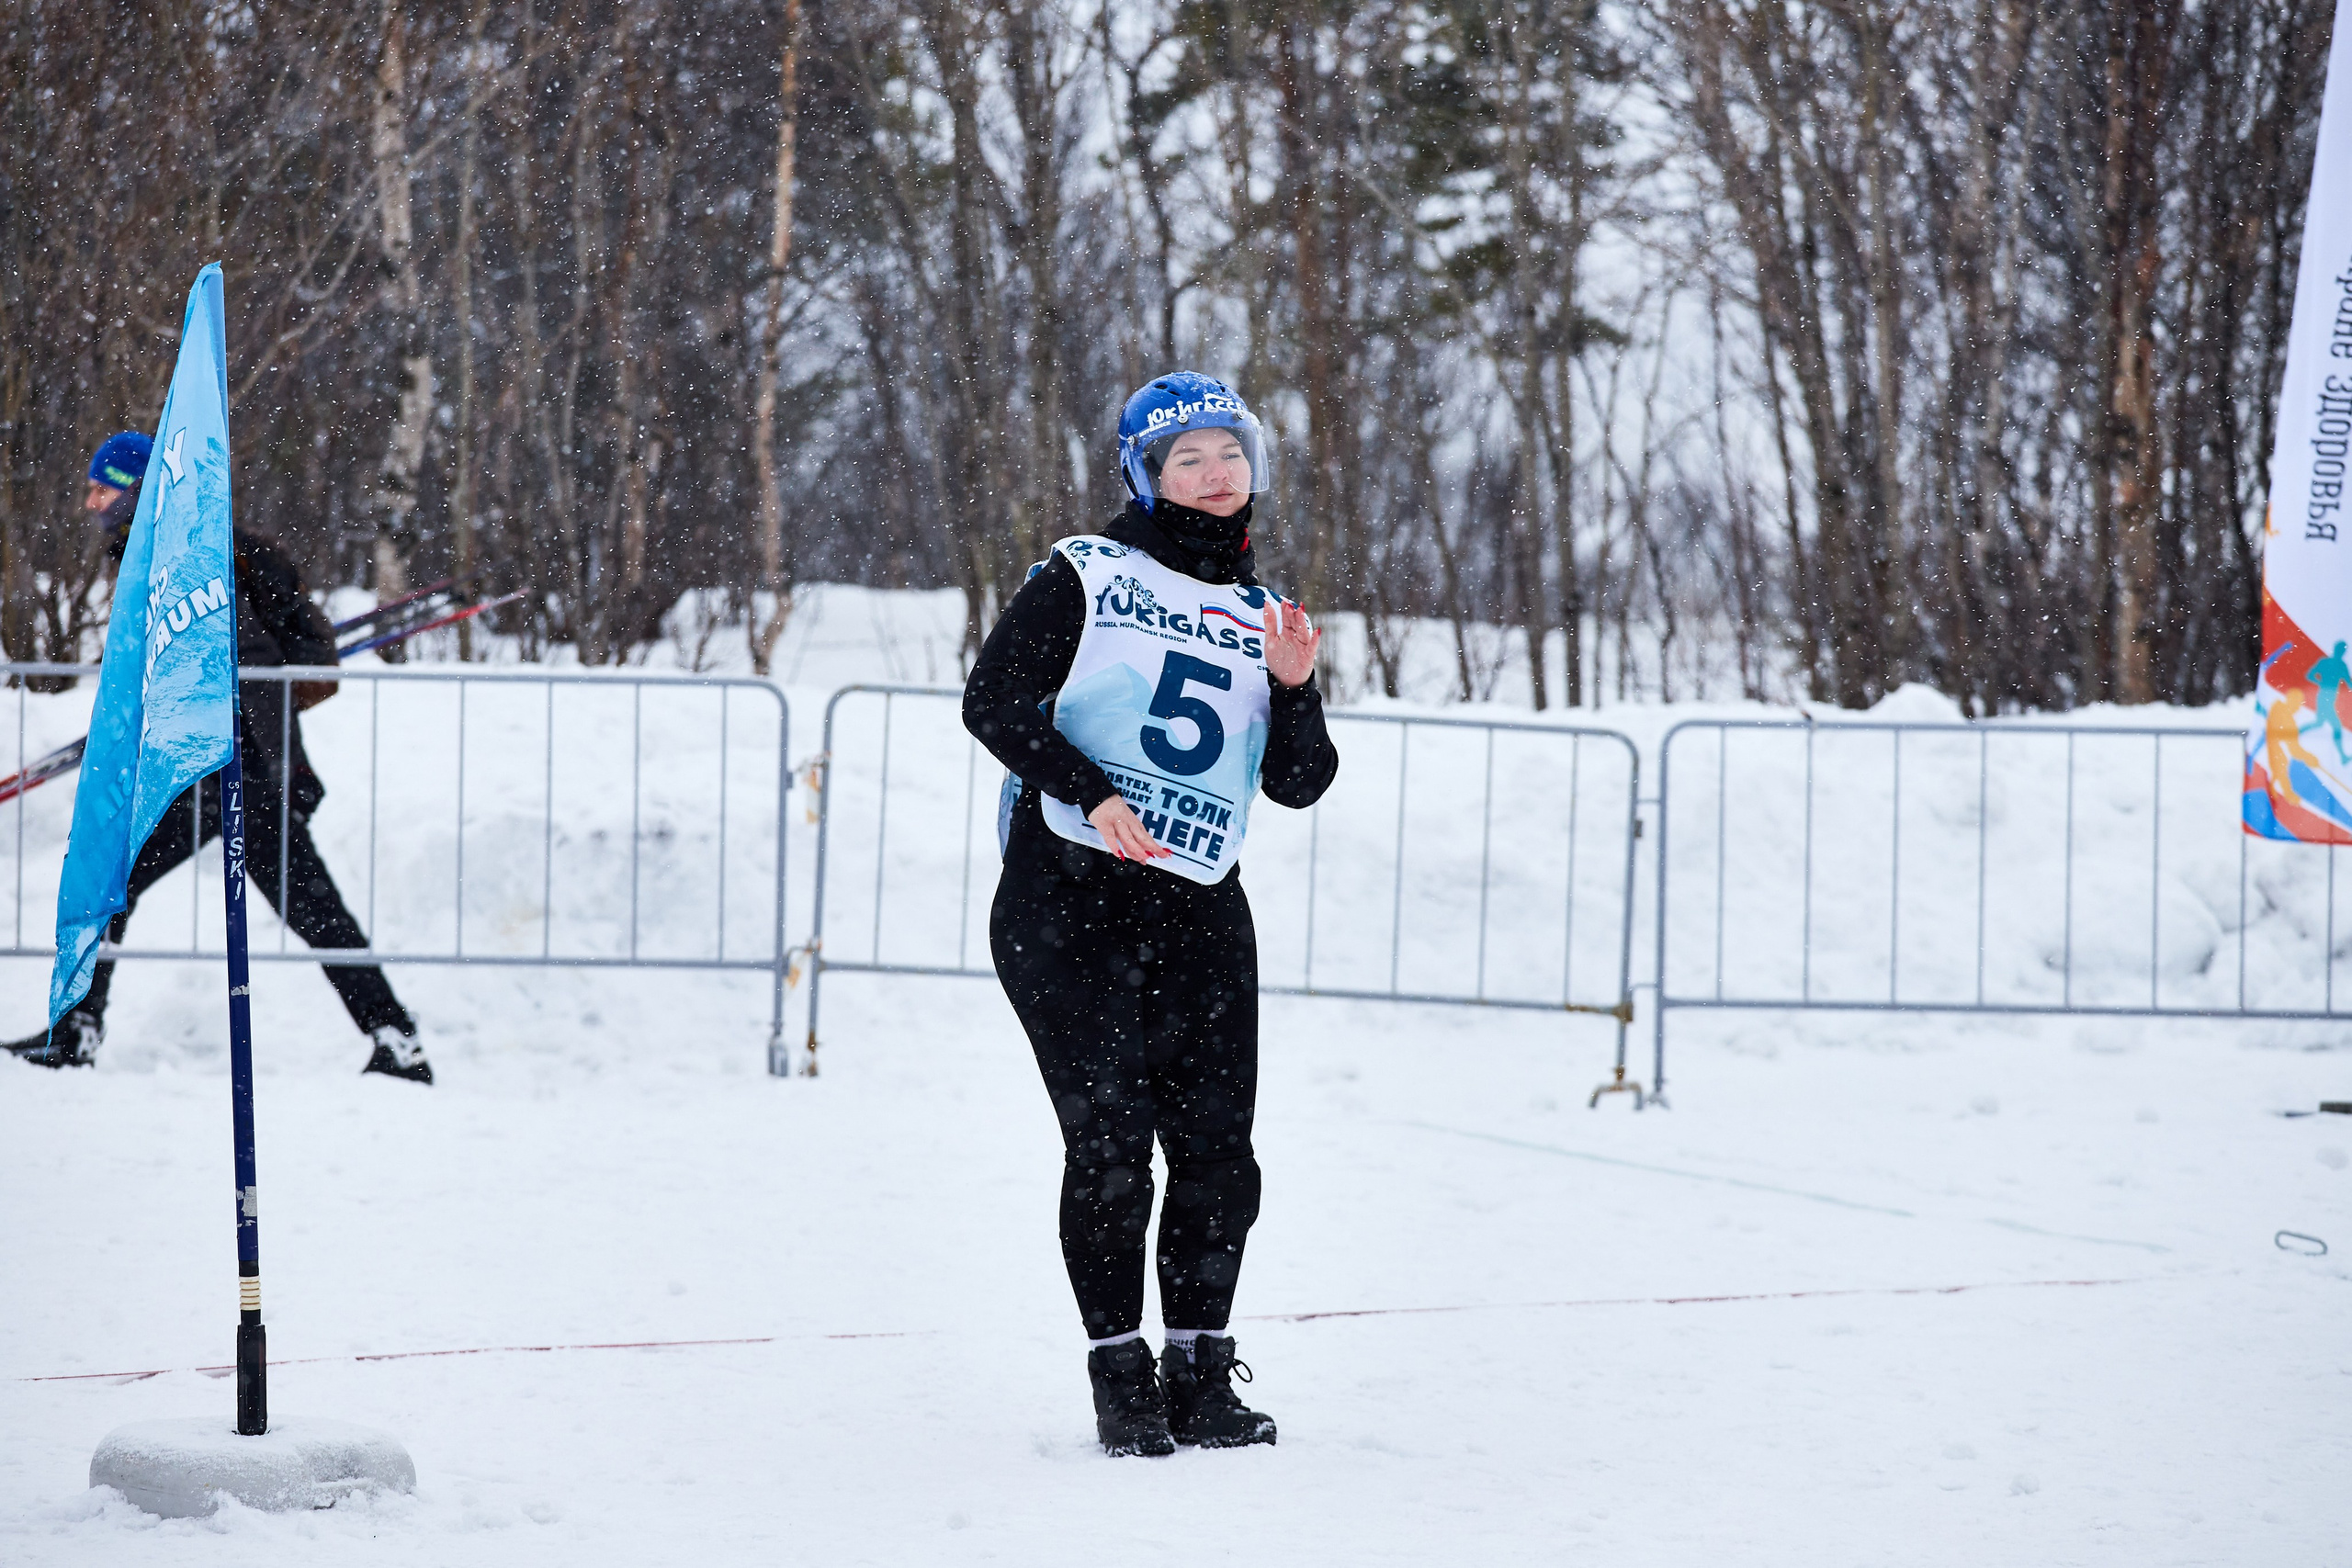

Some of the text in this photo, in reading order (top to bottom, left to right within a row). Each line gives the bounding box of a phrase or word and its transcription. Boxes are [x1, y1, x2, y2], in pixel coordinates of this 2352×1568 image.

[2306, 375, 2352, 542] здоровья
[1119, 622, 1159, 637] MURMANSK
[1159, 632, 1188, 644] REGION
[1139, 649, 1232, 776] 5
[1104, 771, 1154, 795] ЛЯ ТЕХ,
[1160, 786, 1232, 831] ТОЛК
